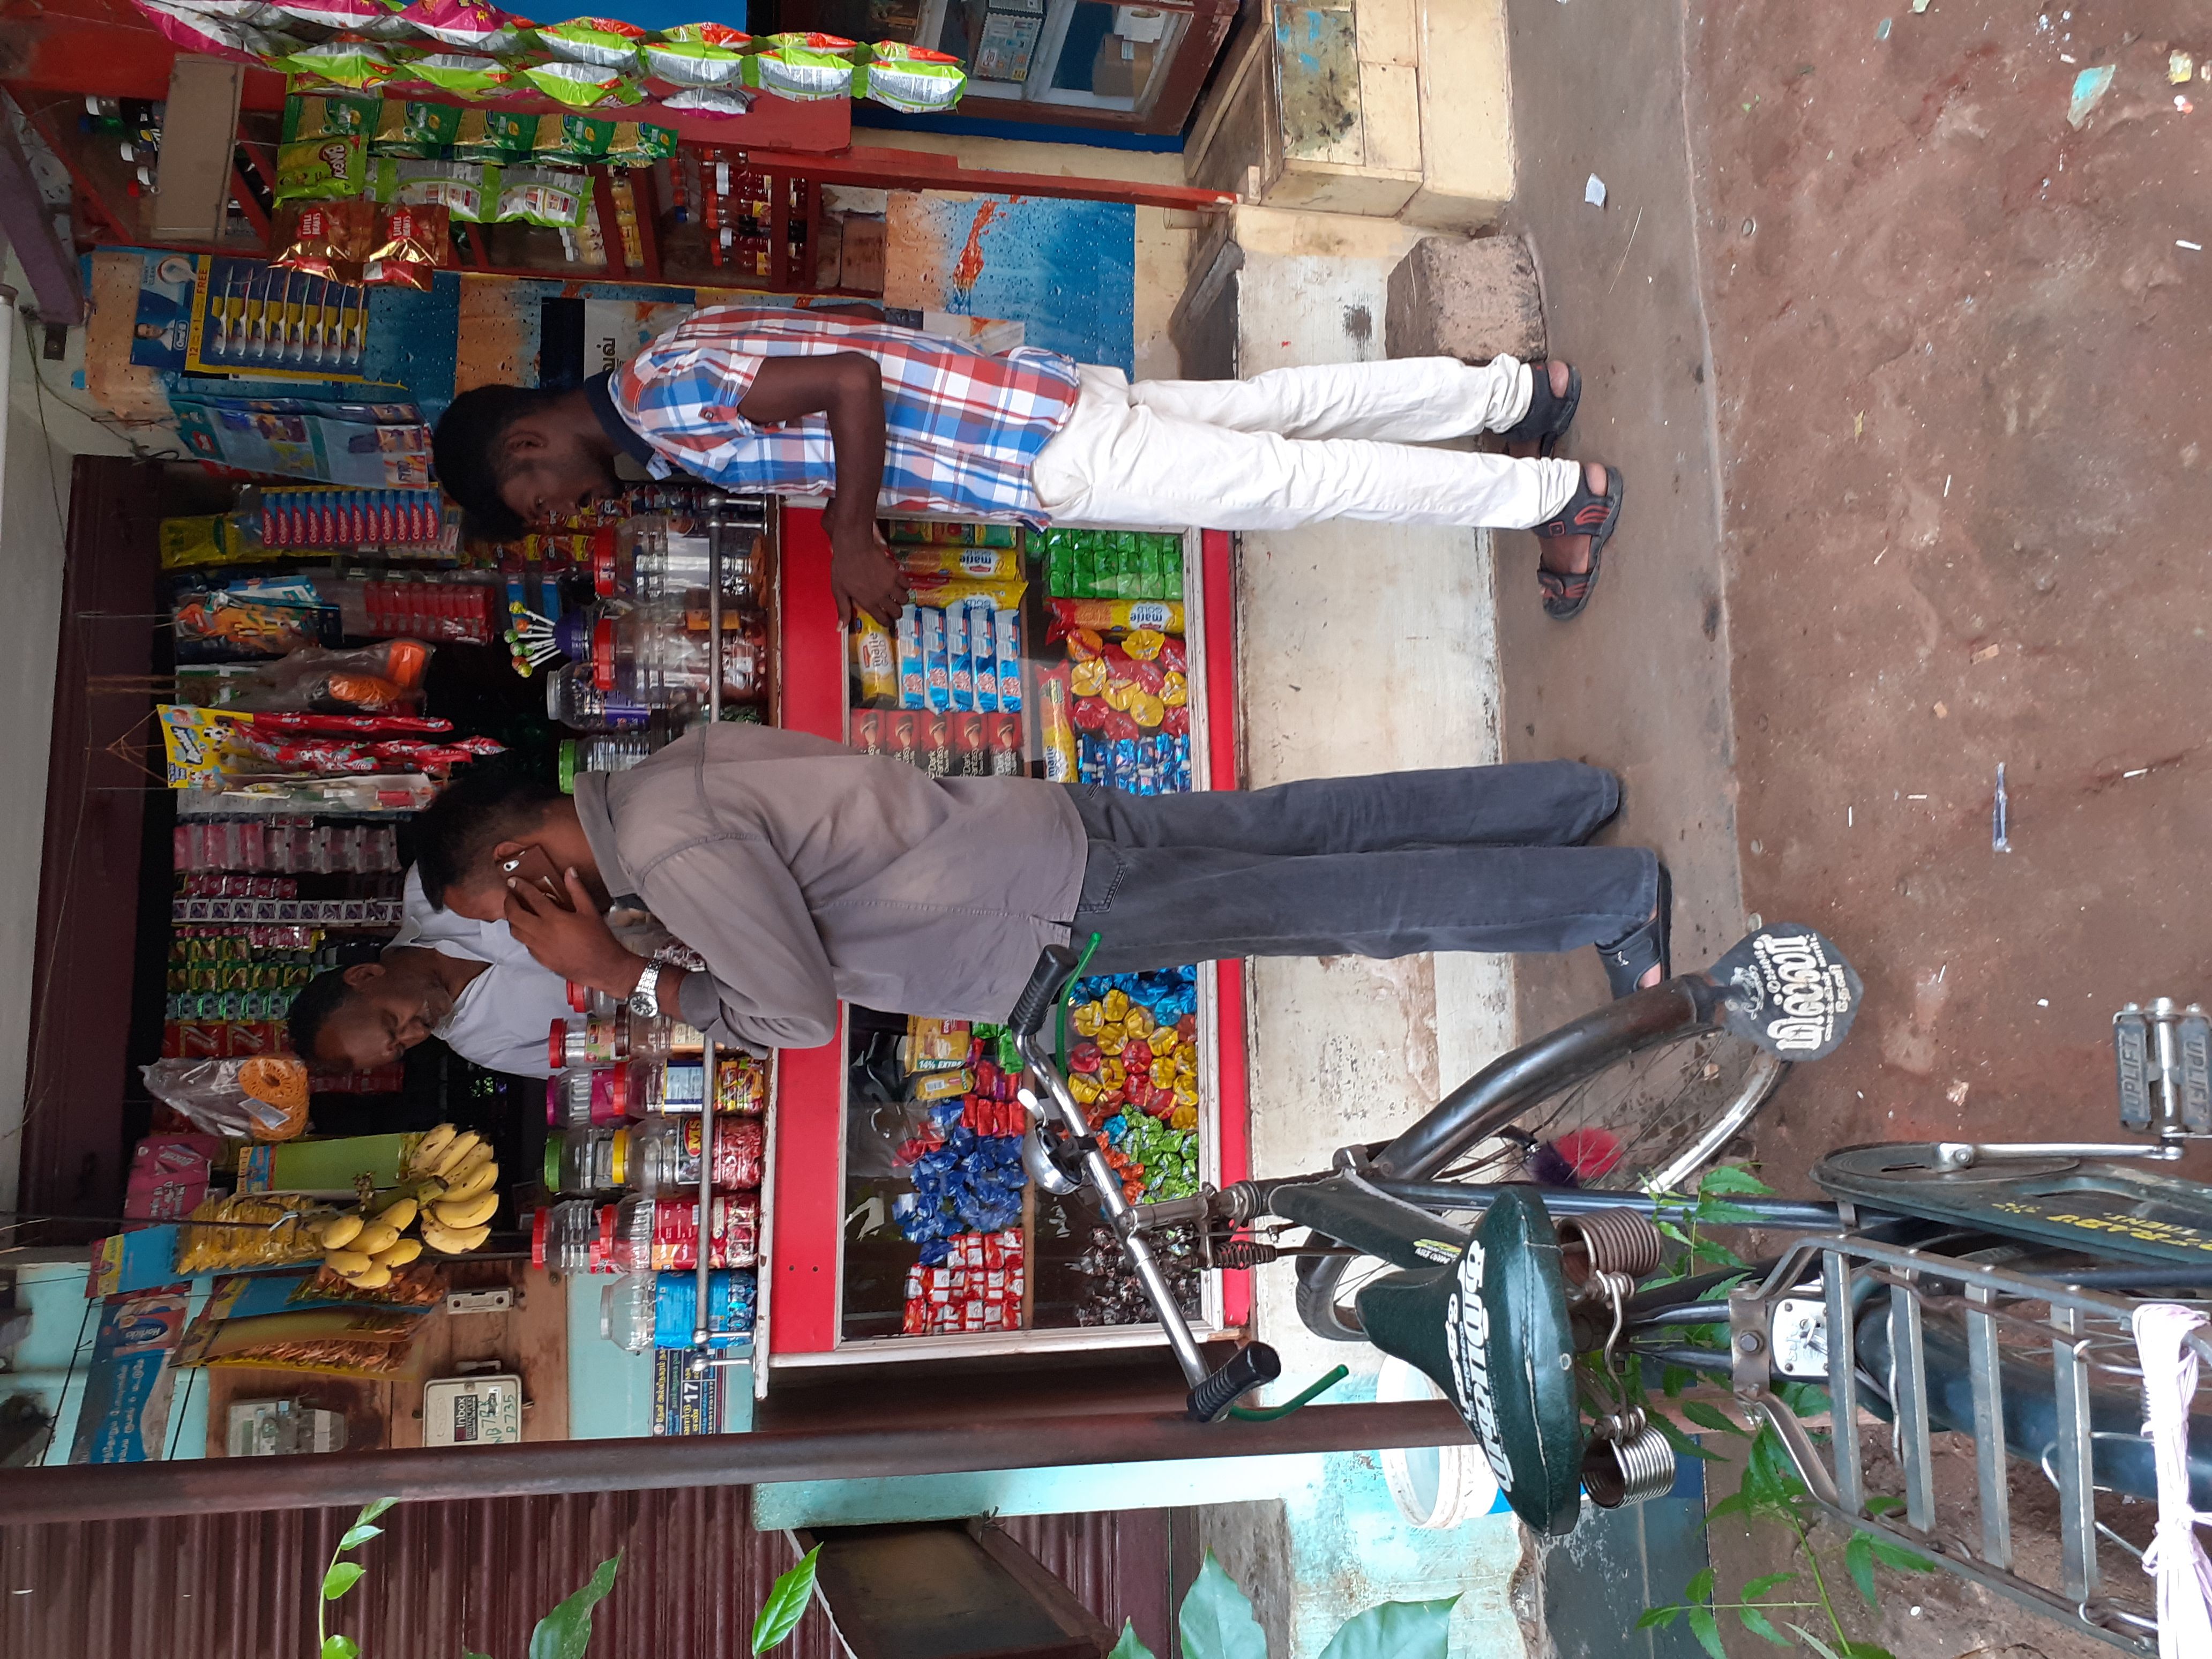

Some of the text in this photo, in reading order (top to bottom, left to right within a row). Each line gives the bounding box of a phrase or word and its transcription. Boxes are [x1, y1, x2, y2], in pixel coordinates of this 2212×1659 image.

[303, 214, 311, 235] LITTLE
[393, 216, 402, 236] LITTLE
[190, 348, 199, 356] 12
[197, 268, 207, 294] FREE
[264, 513, 272, 544] Colgate
[279, 513, 287, 544] Colgate
[294, 513, 302, 543] Colgate
[310, 512, 318, 543] Colgate
[324, 511, 332, 542] Colgate
[339, 511, 347, 542] Colgate
[354, 511, 362, 541] Colgate
[369, 510, 377, 540] Colgate
[383, 510, 391, 540] Colgate
[398, 510, 406, 540] Colgate
[959, 555, 991, 563] marie
[1130, 612, 1163, 621] marie
[869, 632, 880, 667] marie
[928, 750, 937, 771] Dark
[935, 745, 945, 778] Fantasy
[962, 752, 971, 773] Dark
[996, 752, 1004, 774] Dark
[1045, 745, 1055, 777] marie
[1828, 964, 1851, 1013] தேனி
[2118, 1034, 2140, 1107] UPLIFT
[2184, 1039, 2207, 1115] UPLIFT
[688, 1119, 701, 1149] MS
[1445, 1292, 1472, 1421] தேனி
[684, 1382, 698, 1403] 17
[455, 1397, 466, 1428] Inbox
